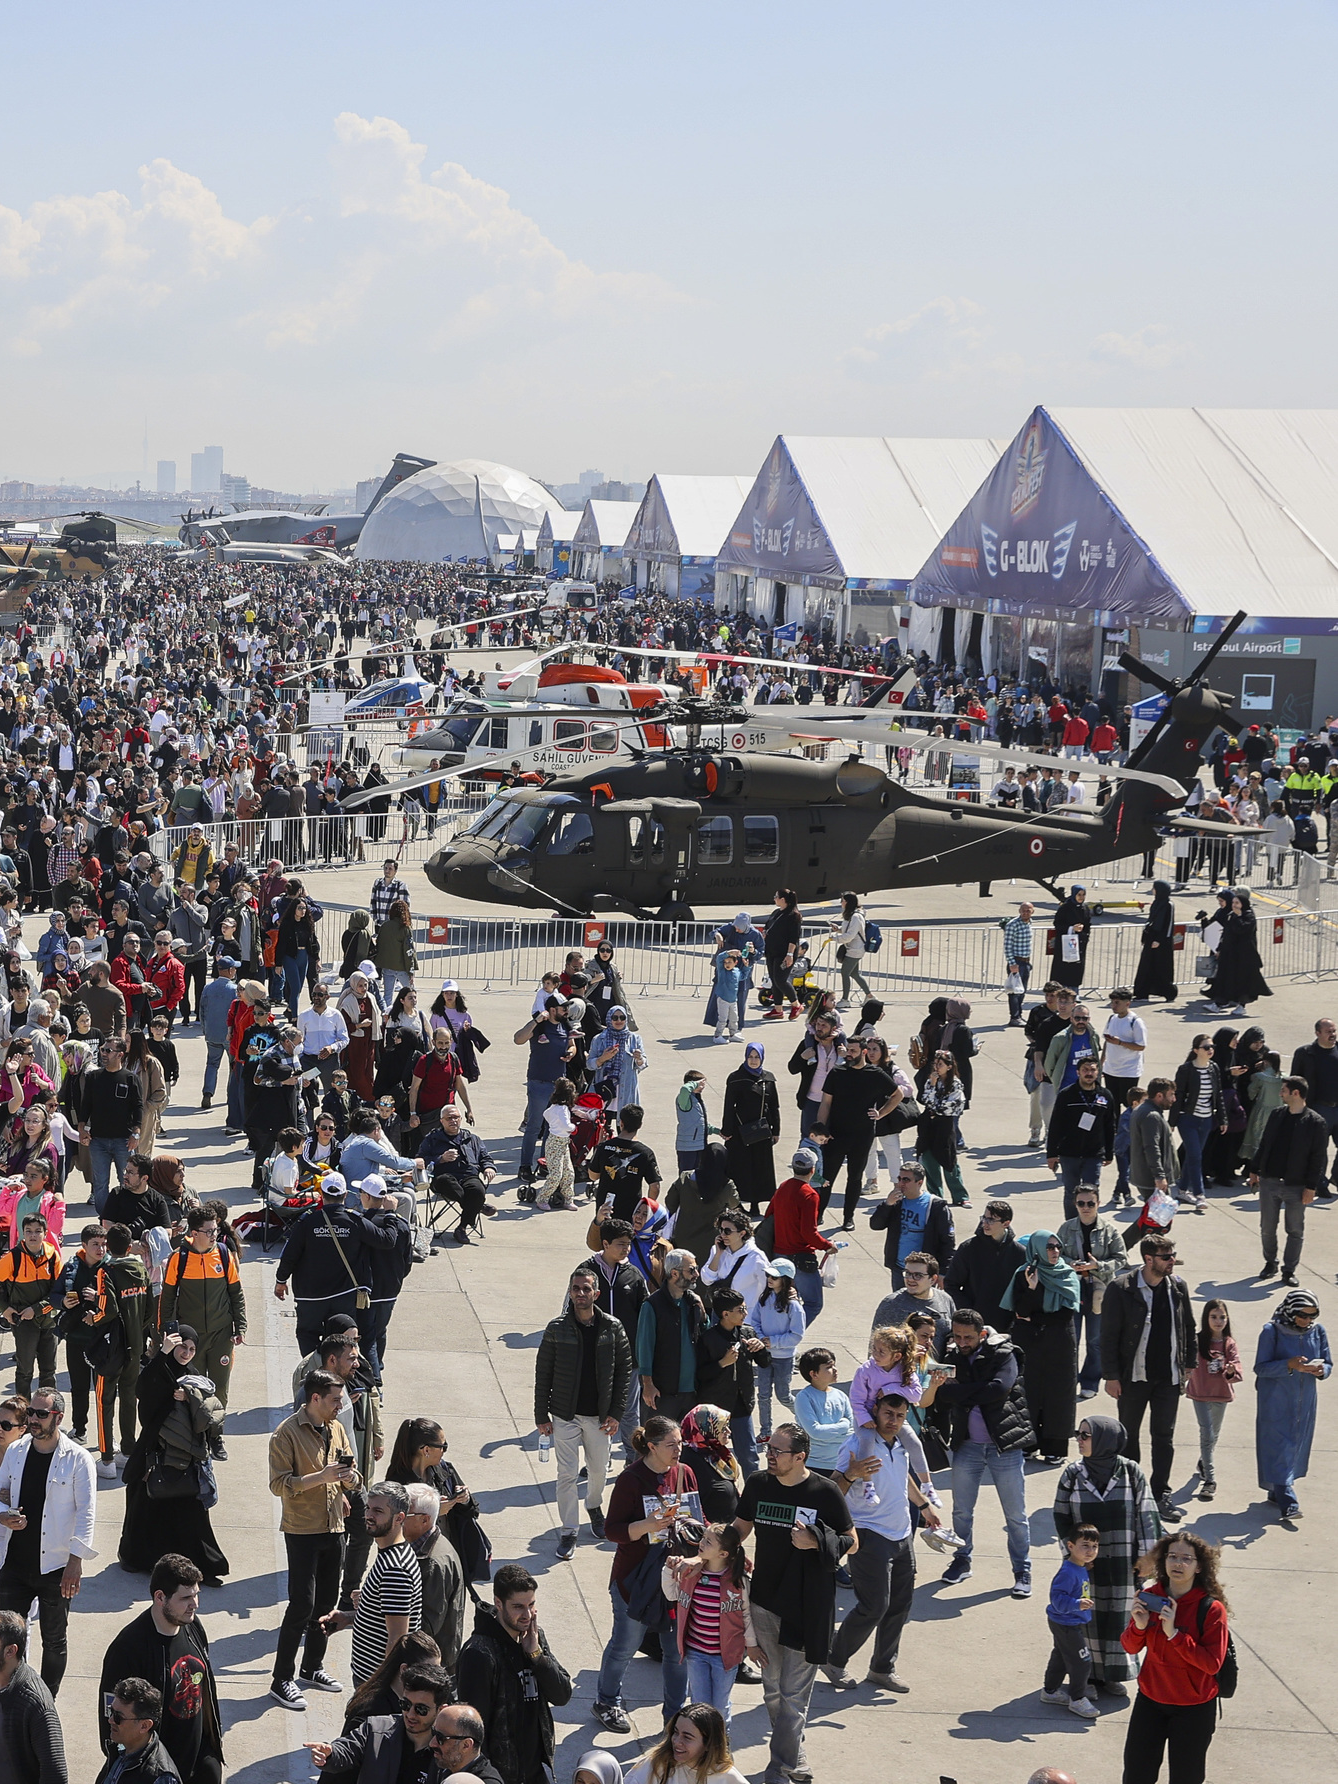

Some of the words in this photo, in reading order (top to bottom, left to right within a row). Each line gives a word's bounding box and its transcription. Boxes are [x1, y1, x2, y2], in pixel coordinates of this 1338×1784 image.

[1000, 540, 1049, 573] G-BLOK
[1242, 641, 1282, 654] Airport
[701, 736, 728, 748] TCSG
[750, 732, 766, 745] 515
[532, 752, 564, 763] SAHİL
[706, 876, 768, 888] JANDARMA
[314, 1226, 350, 1234] GÖKÜRK
[758, 1504, 792, 1520] PUMA
